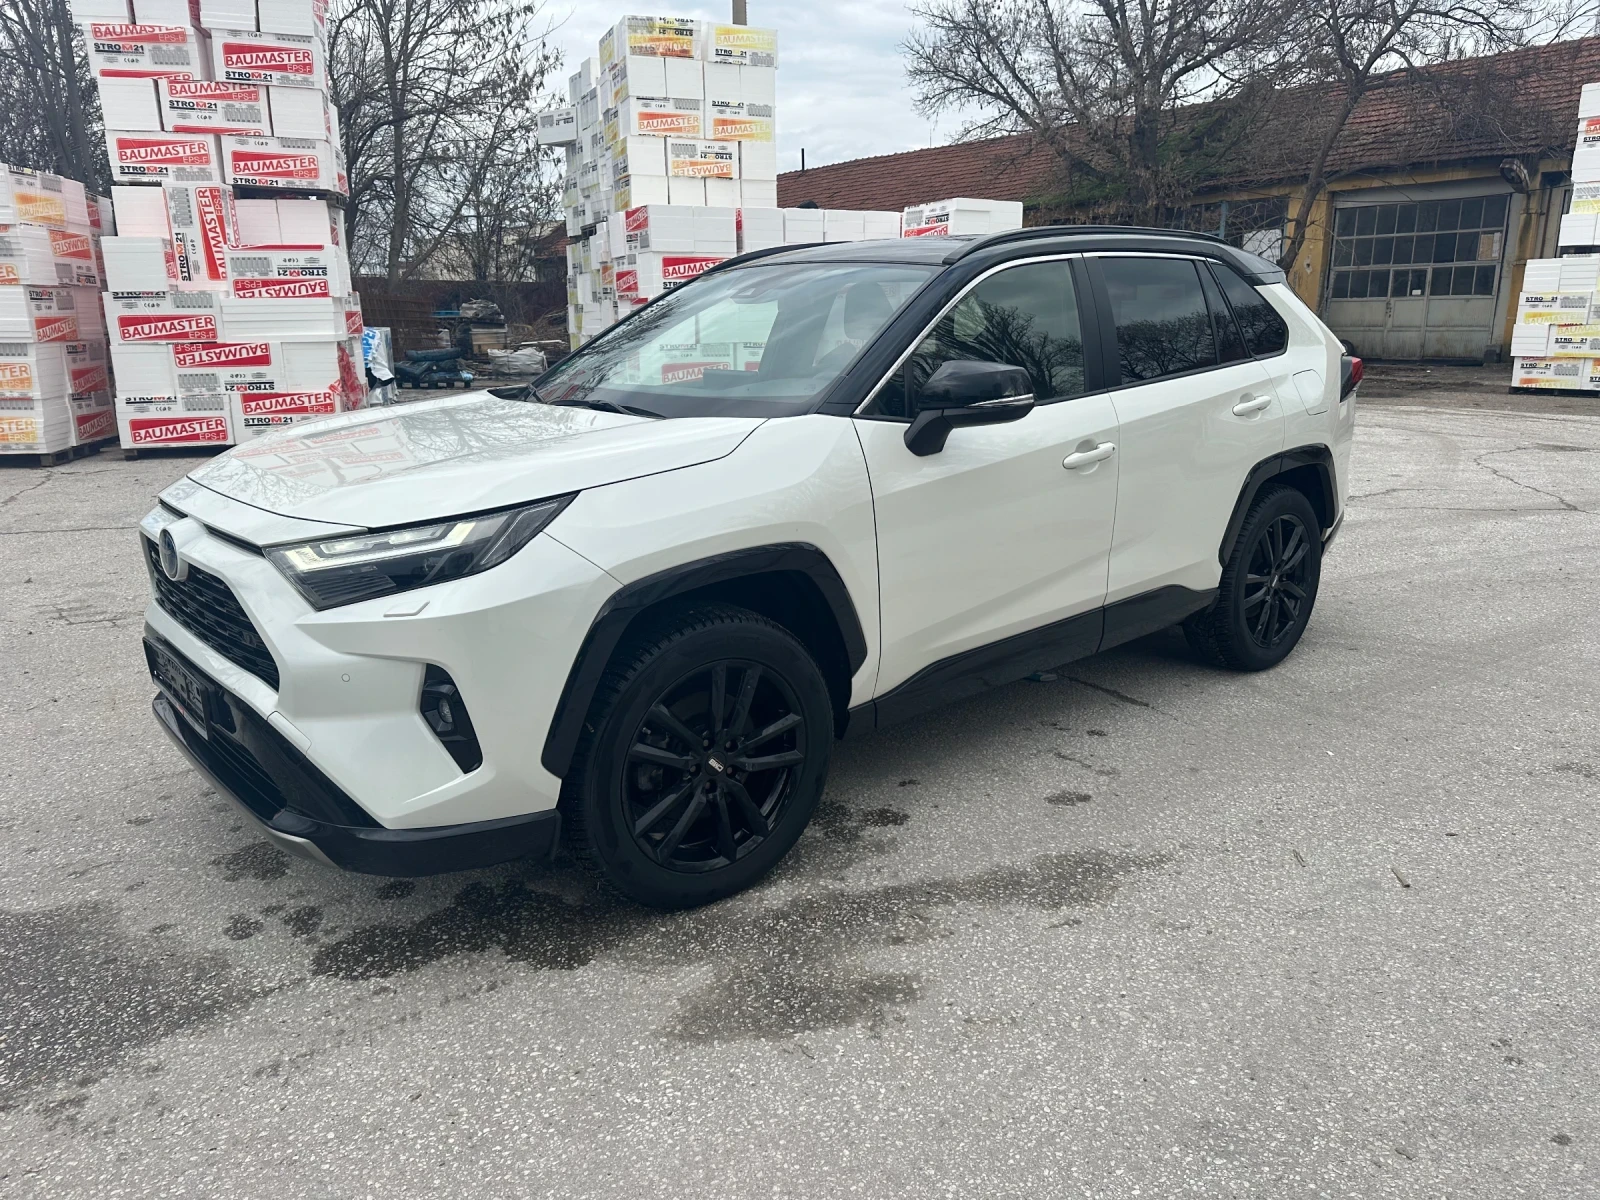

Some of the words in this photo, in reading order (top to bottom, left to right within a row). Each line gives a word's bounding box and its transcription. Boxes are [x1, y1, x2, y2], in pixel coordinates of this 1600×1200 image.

[93, 25, 185, 38] BAUMAS
[158, 33, 184, 42] EPS-F
[225, 51, 311, 66] BAUMASTER
[287, 64, 311, 72] EPS-F
[232, 92, 257, 100] EPS-F
[640, 116, 699, 129] BAUMASTER
[714, 123, 771, 135] BAUMASTER
[120, 142, 207, 161] BAUMASTER
[183, 156, 208, 164] EPS-F
[233, 157, 317, 172] BAUMASTER
[293, 170, 317, 178] EPS-F
[673, 163, 731, 176] BAUMASTER
[212, 189, 222, 215] EPS-F
[53, 238, 90, 255] BAUMASTER
[37, 317, 76, 341] BAUMASTER
[122, 317, 214, 339] BAUMASTER
[189, 331, 215, 339] EPS-F
[175, 343, 202, 352] EPS-F
[176, 343, 268, 366] BAUMASTER
[2, 380, 30, 388] EPS-F
[74, 367, 105, 391] BAUMASTER
[243, 392, 333, 413] BAUMASTER
[79, 411, 112, 438] BAUMASTER
[132, 419, 225, 442] BAUMASTER
[199, 432, 225, 440] EPS-F
